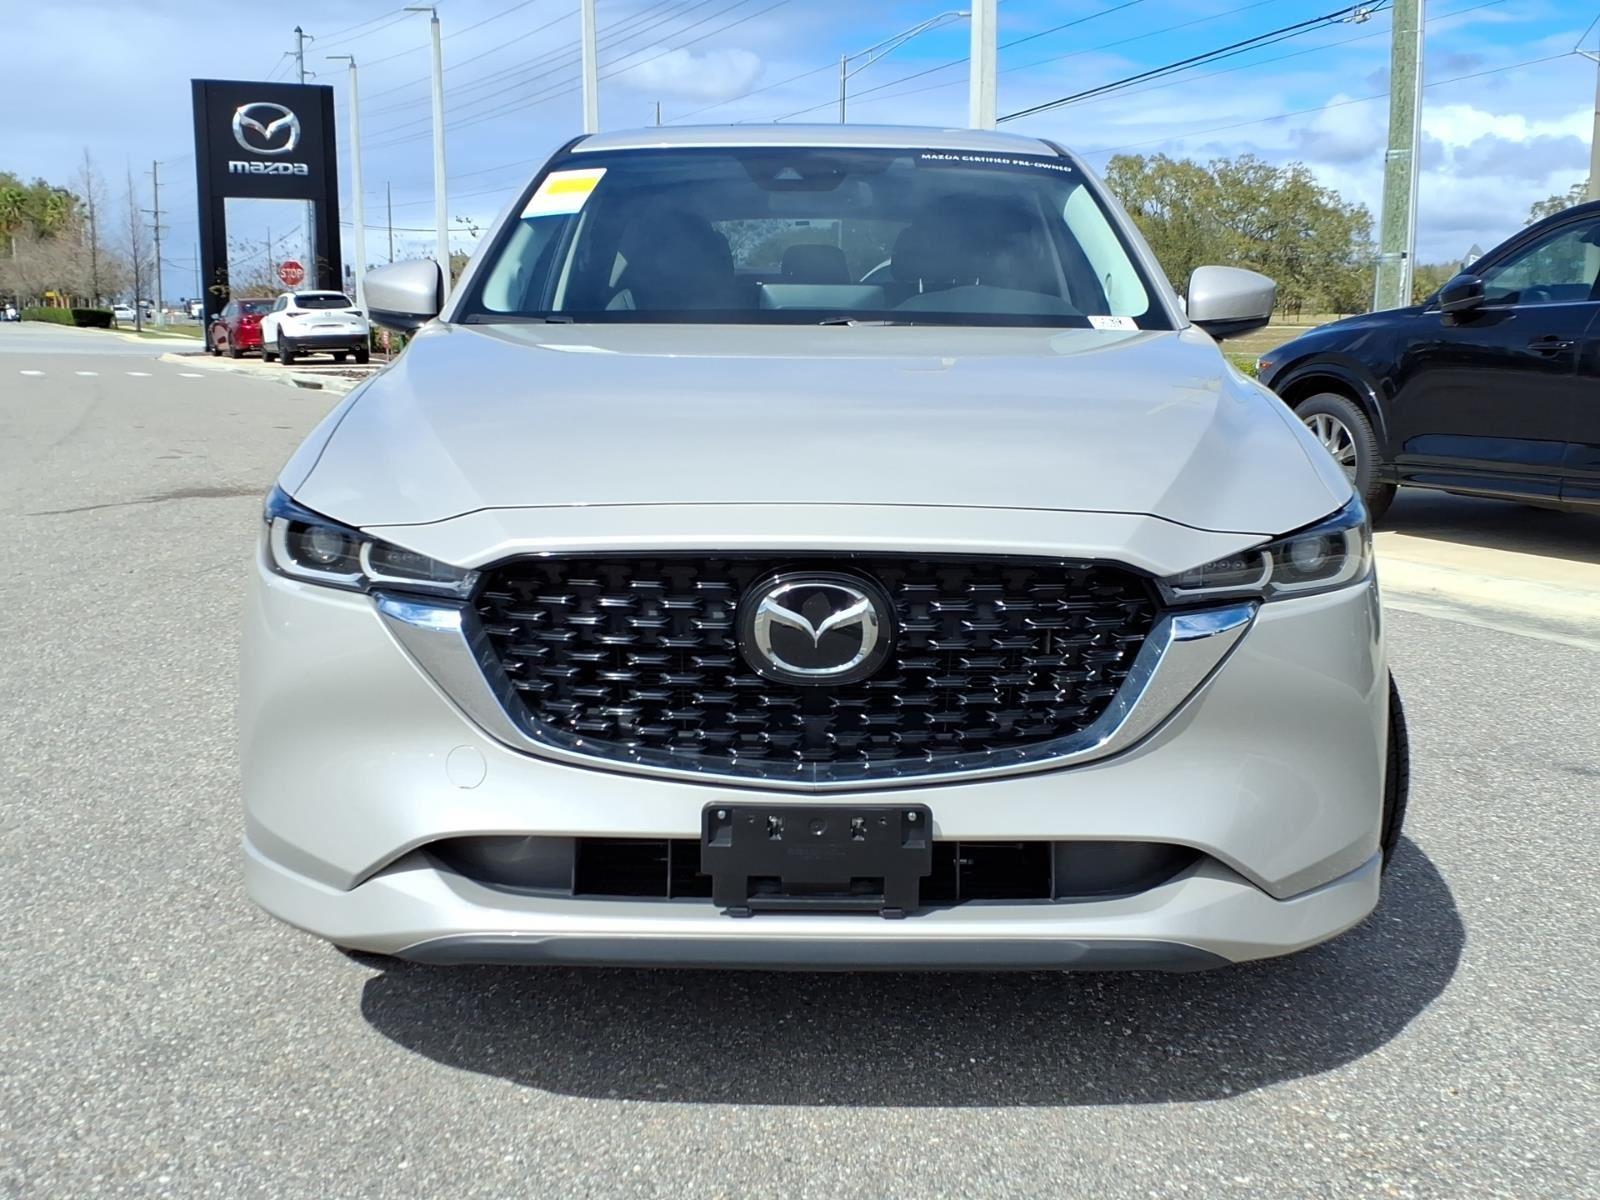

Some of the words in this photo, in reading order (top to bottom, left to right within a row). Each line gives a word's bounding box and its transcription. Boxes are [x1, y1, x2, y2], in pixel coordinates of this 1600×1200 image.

[228, 160, 308, 175] mazda
[961, 155, 1010, 164] CERTIFIED
[1012, 160, 1072, 172] PRE-OWNED
[280, 268, 304, 279] STOP
